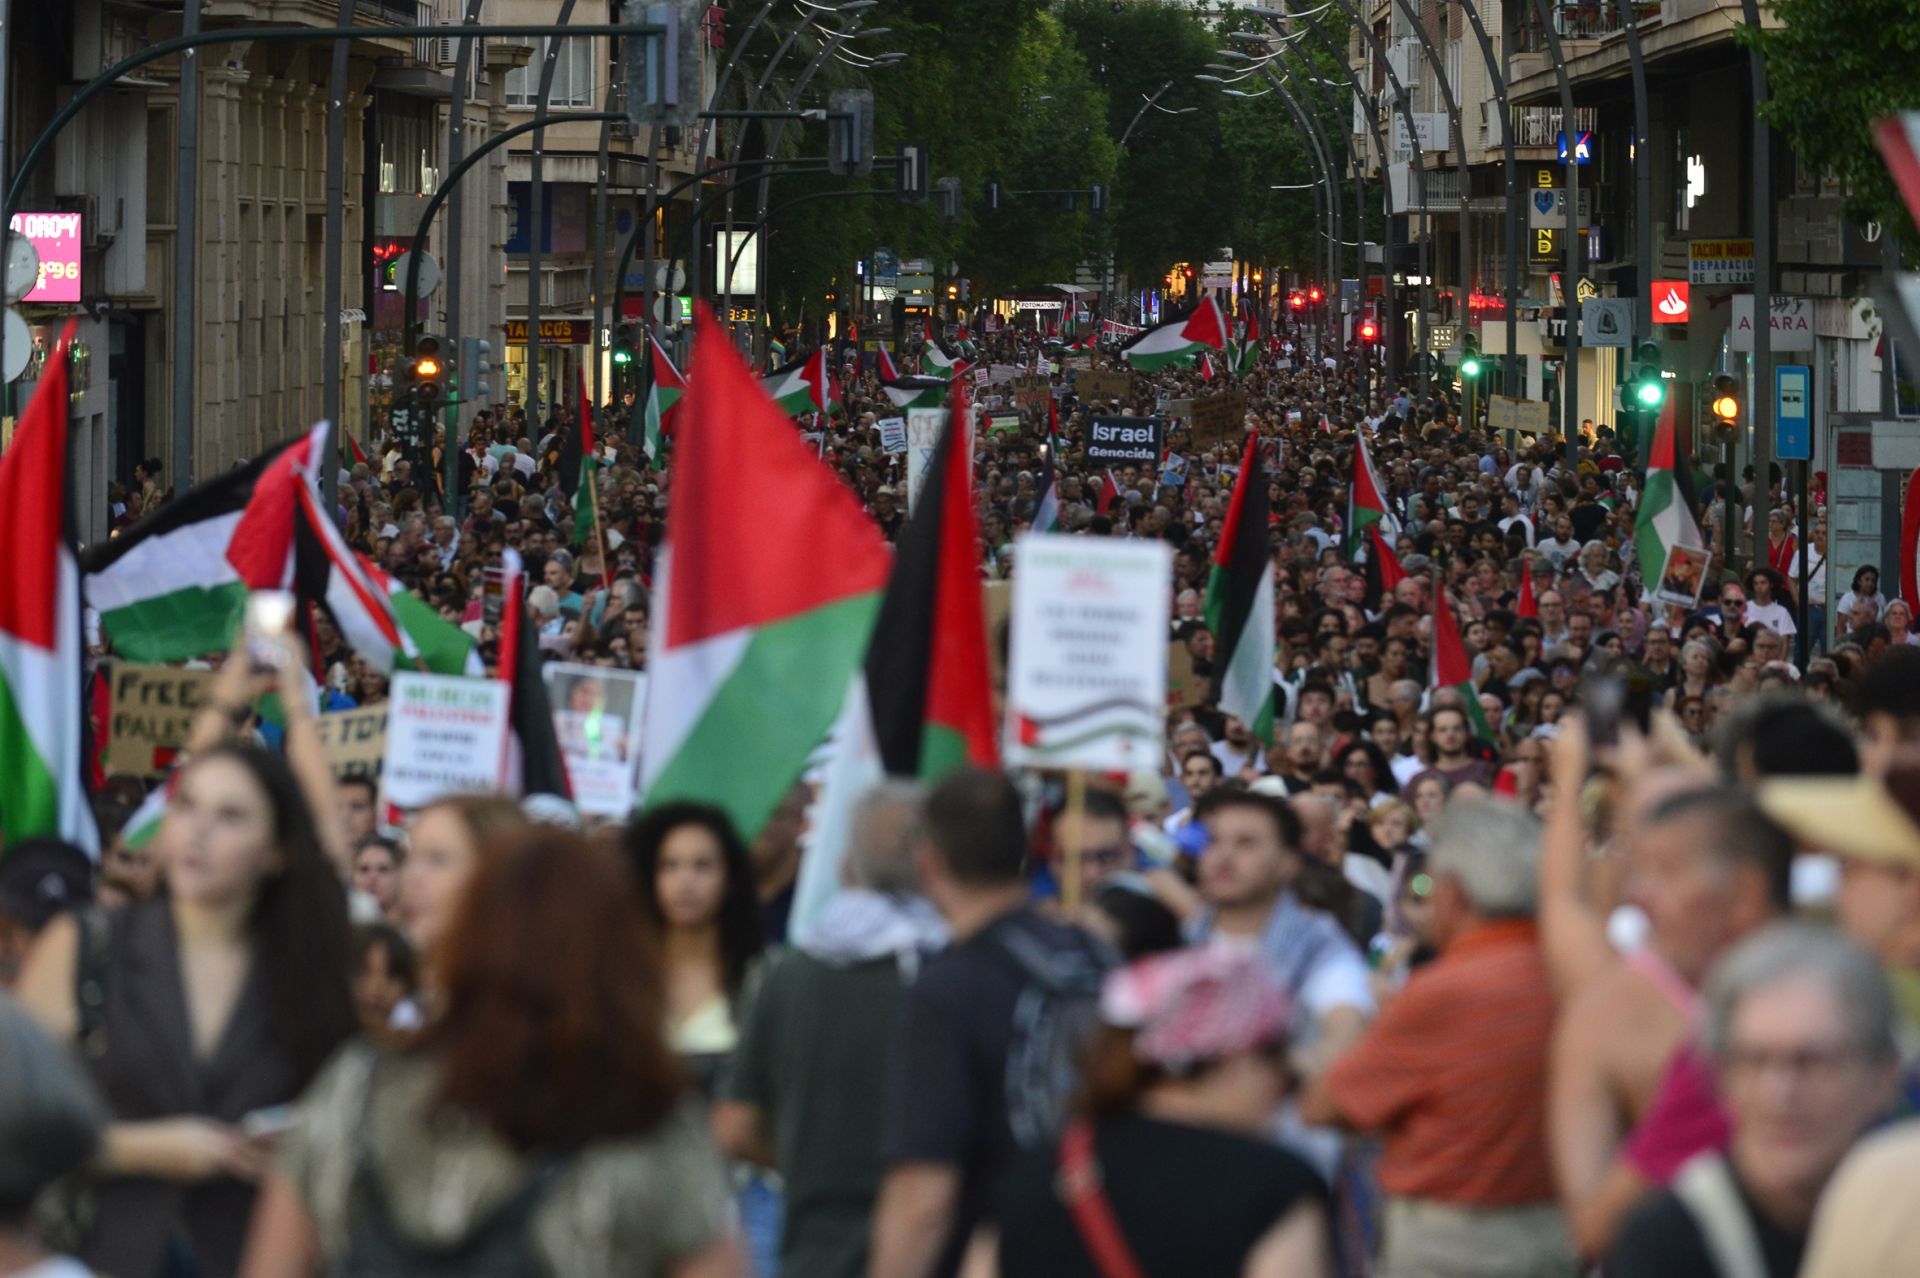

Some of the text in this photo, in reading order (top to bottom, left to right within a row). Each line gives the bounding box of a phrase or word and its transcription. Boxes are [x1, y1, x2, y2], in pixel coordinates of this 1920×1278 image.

[1727, 243, 1754, 257] MINUT
[1693, 261, 1753, 270] REPARACIO
[508, 321, 572, 336] TAACOS
[1739, 317, 1808, 330] AARA
[1092, 421, 1155, 443] Israel
[1088, 446, 1156, 461] Genocida
